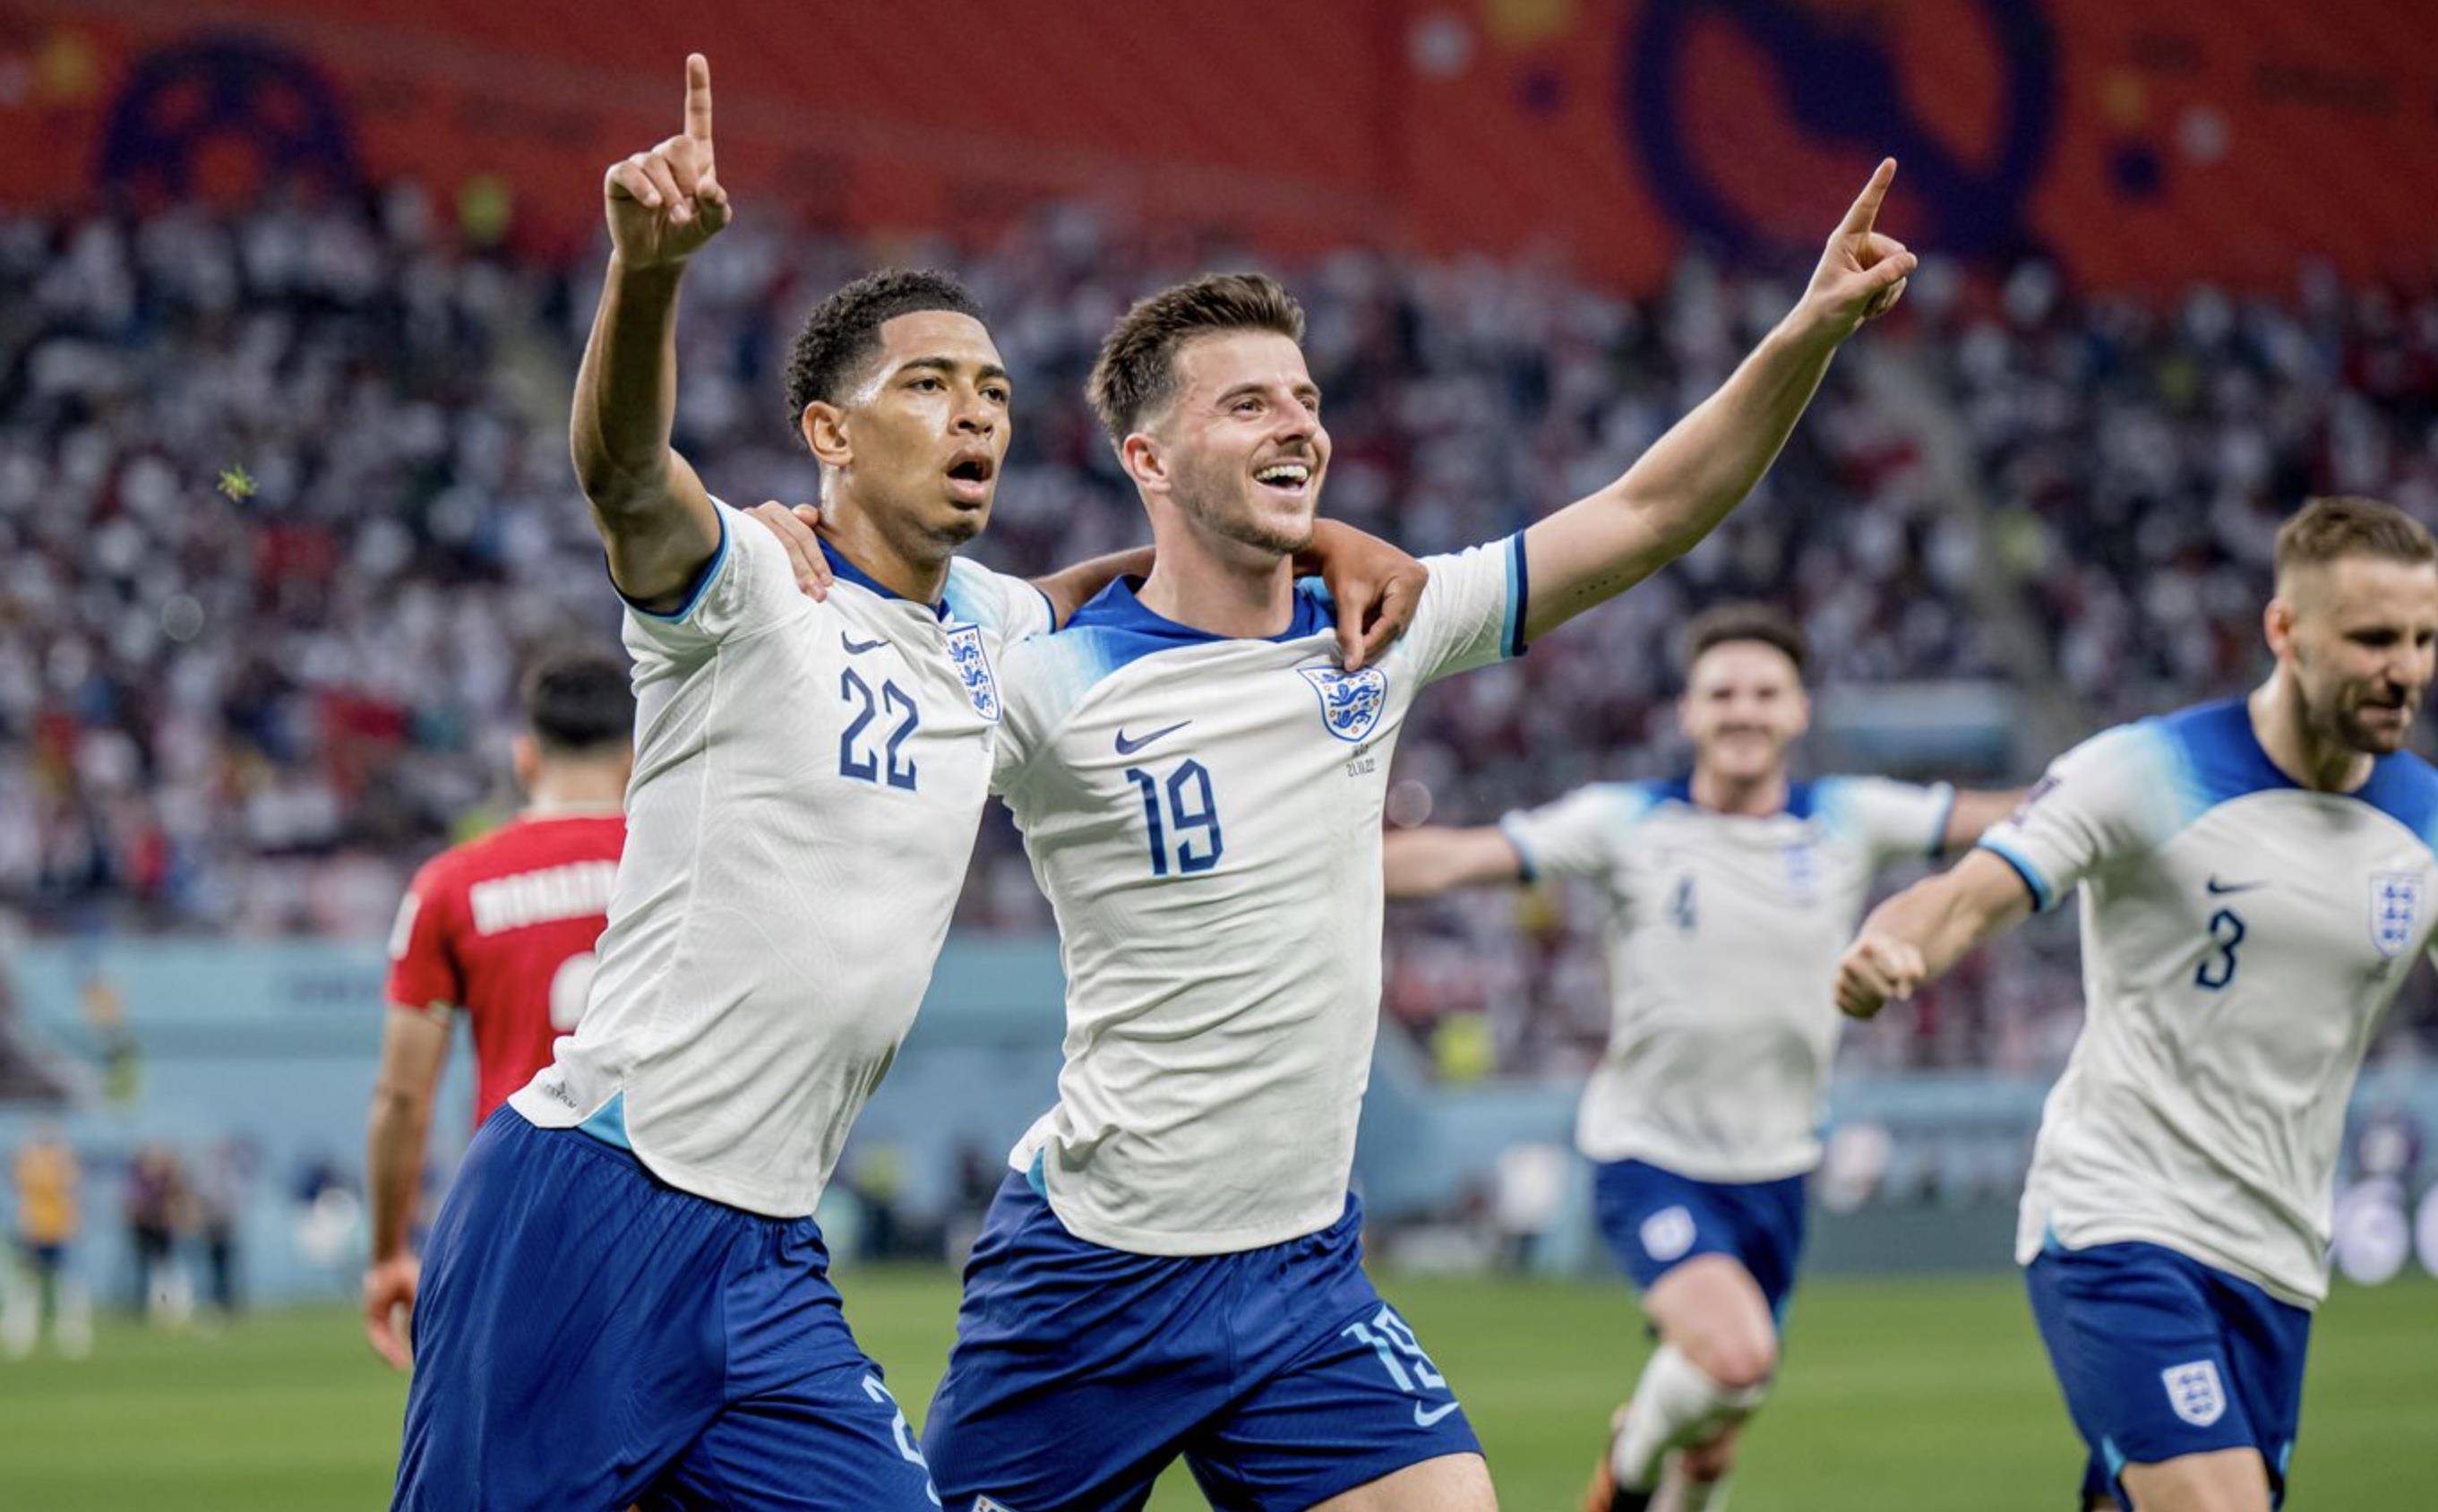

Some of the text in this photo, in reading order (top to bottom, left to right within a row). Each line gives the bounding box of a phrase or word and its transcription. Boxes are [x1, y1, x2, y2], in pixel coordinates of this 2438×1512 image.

[839, 666, 920, 792] 22
[1124, 758, 1224, 876] 19
[2194, 907, 2246, 991] 3
[1341, 1304, 1447, 1392] 19
[862, 1374, 942, 1508] 2
